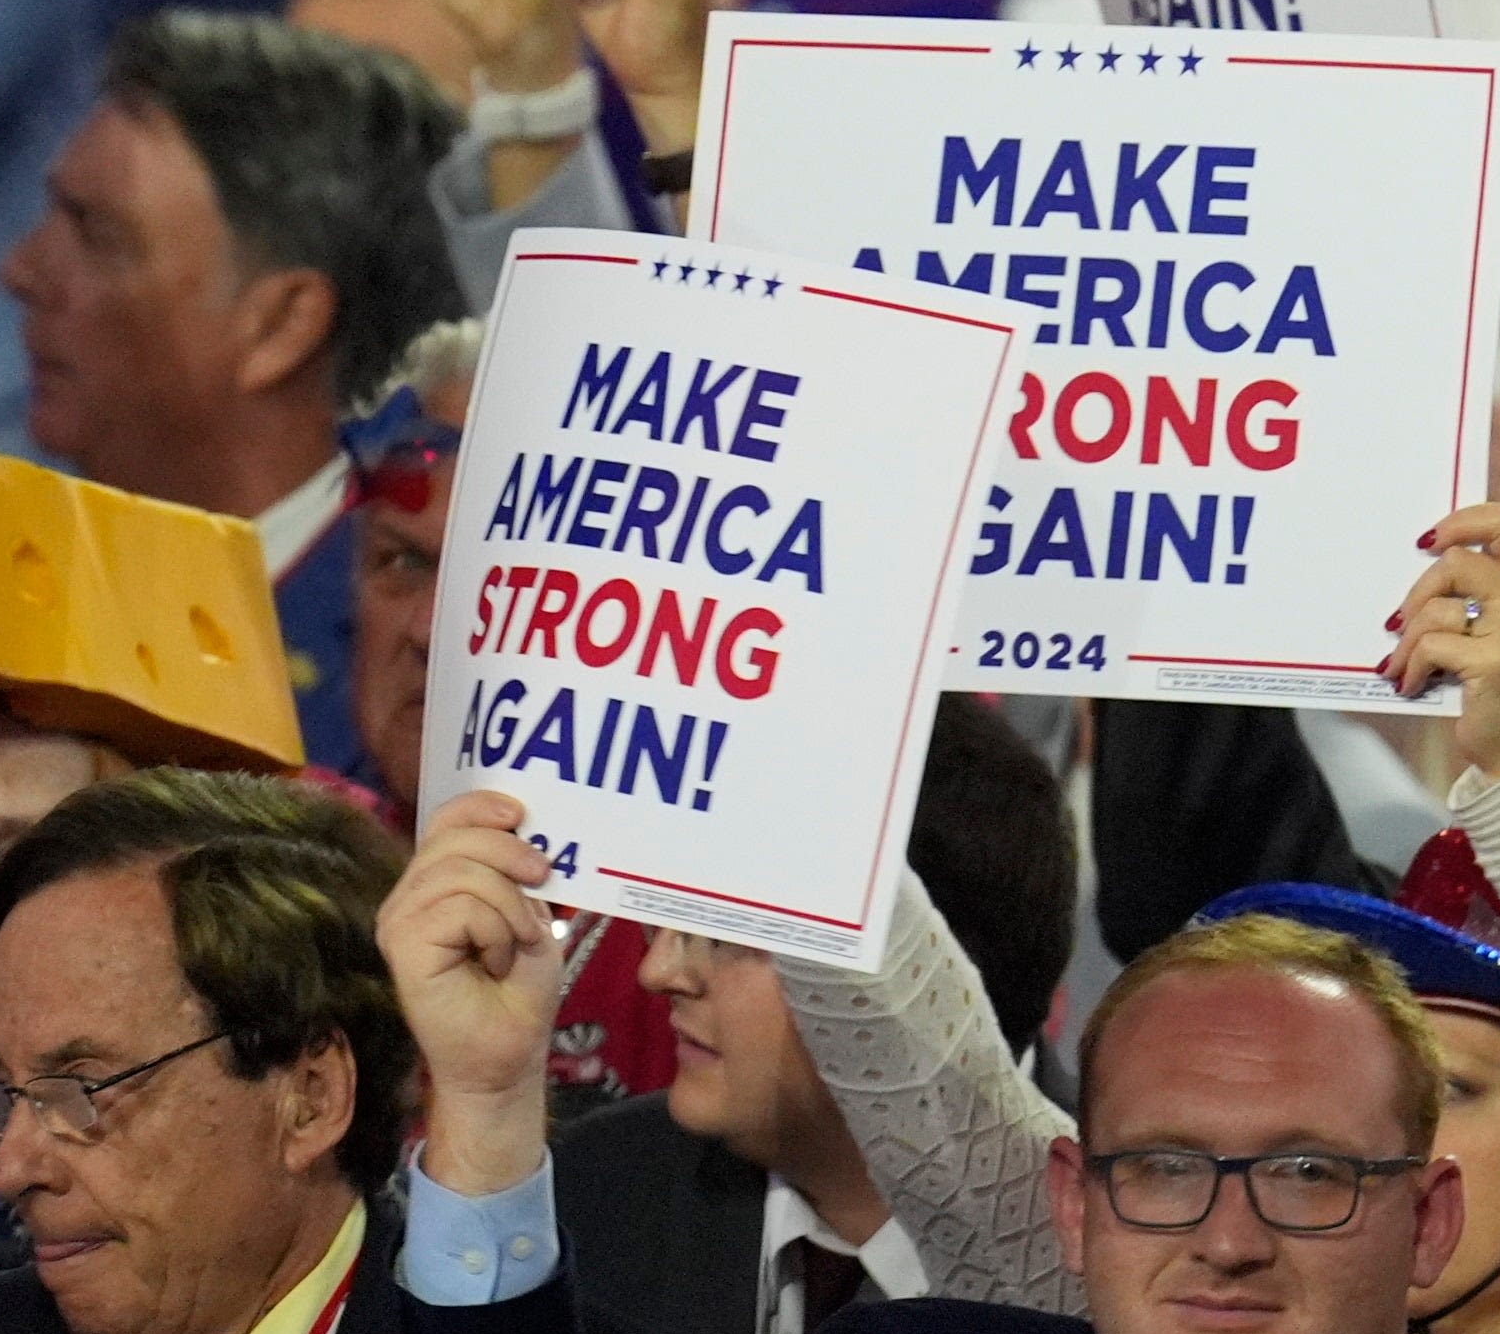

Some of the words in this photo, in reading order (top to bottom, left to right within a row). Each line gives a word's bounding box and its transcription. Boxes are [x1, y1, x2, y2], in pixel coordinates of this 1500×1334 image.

[934, 134, 1257, 237] MAKE
[851, 247, 1336, 358] ERICA
[560, 341, 801, 463] MAKE
[1007, 370, 1300, 473] RONG
[484, 452, 826, 595] AMERICA
[970, 486, 1254, 587] GAIN!
[467, 564, 785, 701] STRONG
[978, 630, 1107, 674] 2024
[457, 678, 731, 814] AGAIN!
[529, 832, 581, 881] 24
